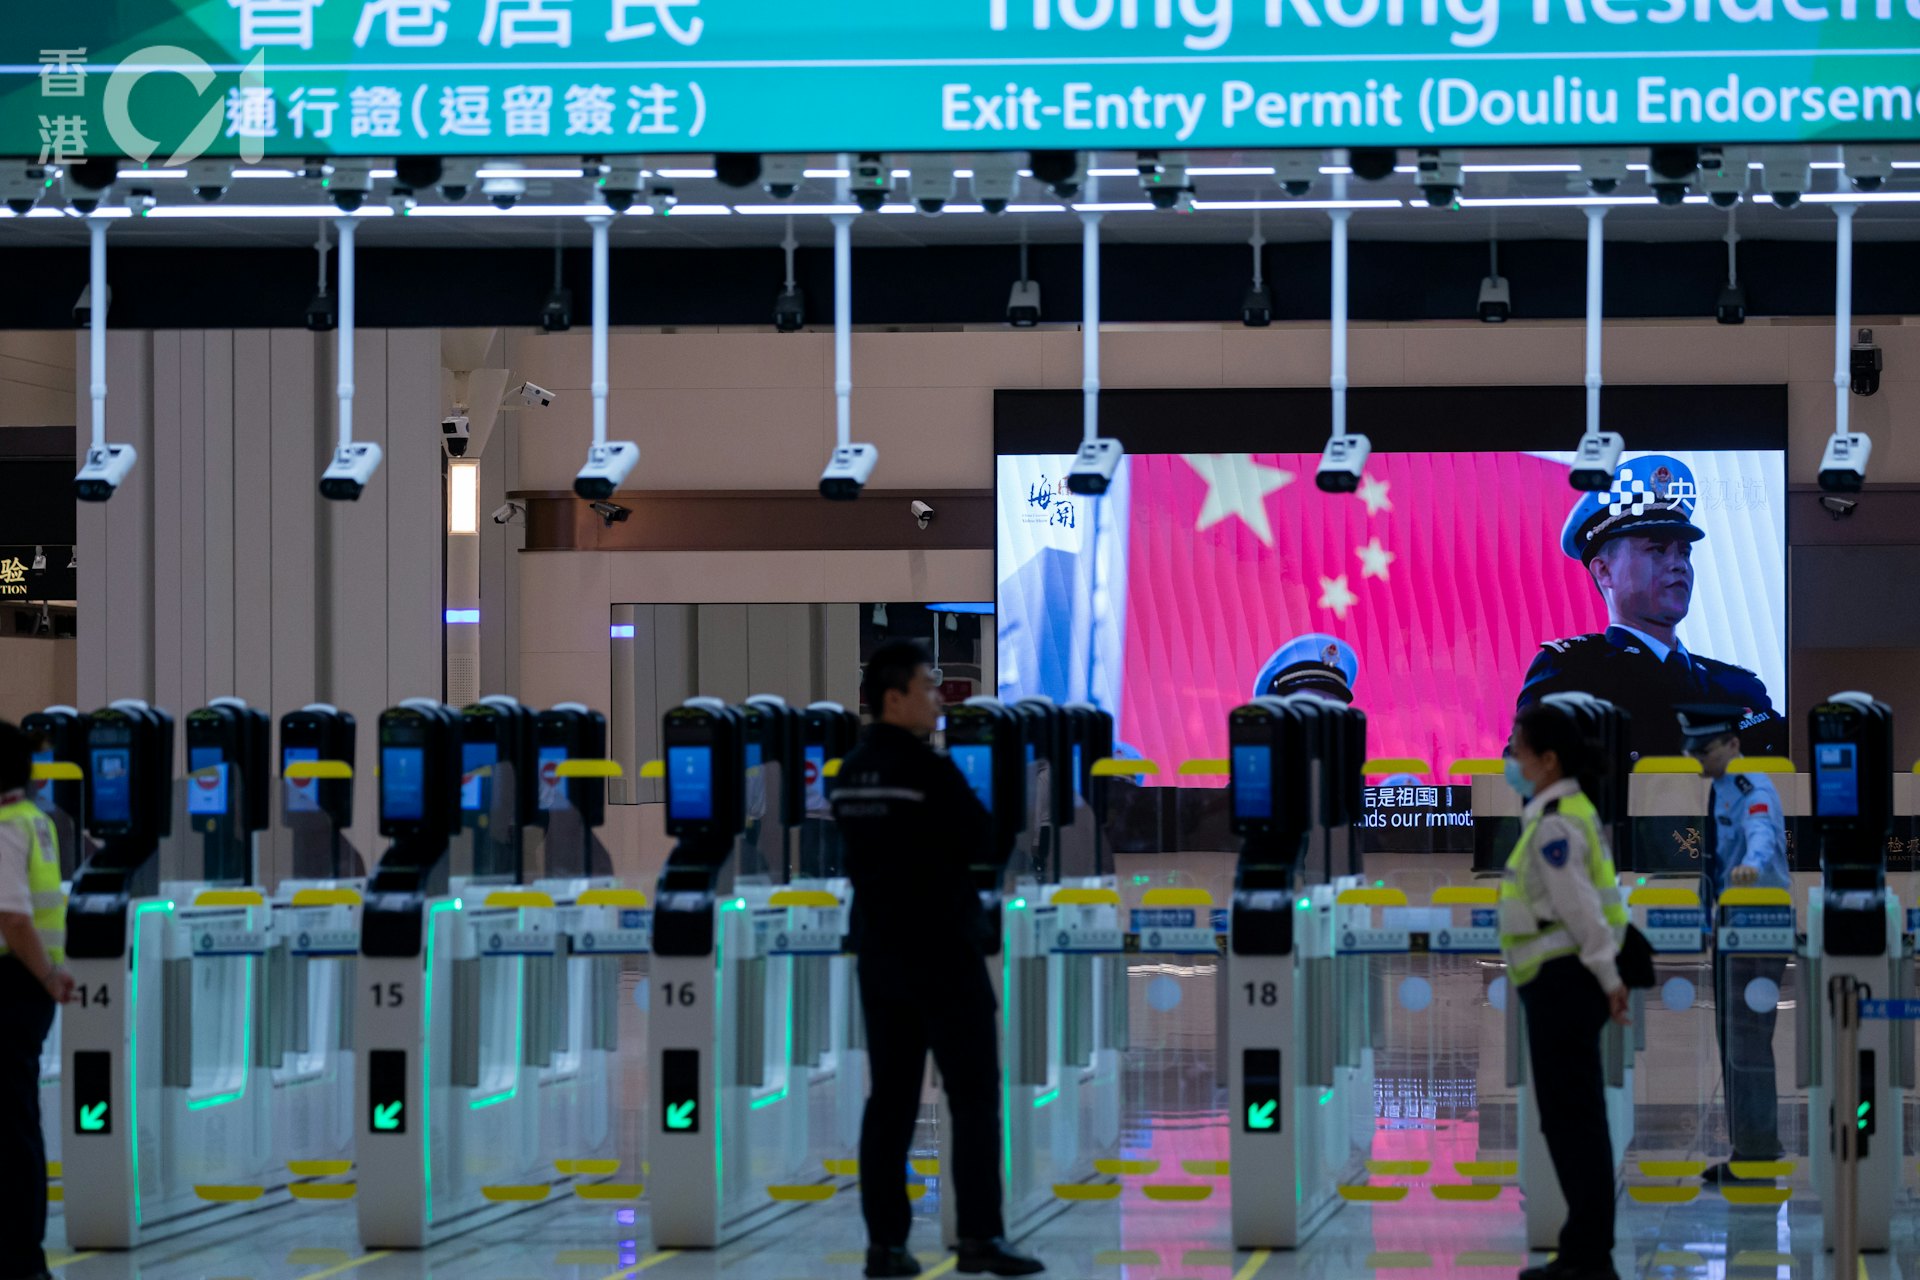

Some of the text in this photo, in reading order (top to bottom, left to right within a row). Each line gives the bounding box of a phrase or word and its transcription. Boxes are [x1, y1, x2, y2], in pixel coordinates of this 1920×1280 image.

[942, 73, 1920, 141] Exit-Entry Permit (Douliu Endorsem
[0, 585, 28, 595] TION
[1391, 813, 1422, 828] our
[78, 984, 112, 1009] 14
[370, 983, 403, 1008] 15
[662, 982, 695, 1007] 16
[1244, 982, 1277, 1007] 18
